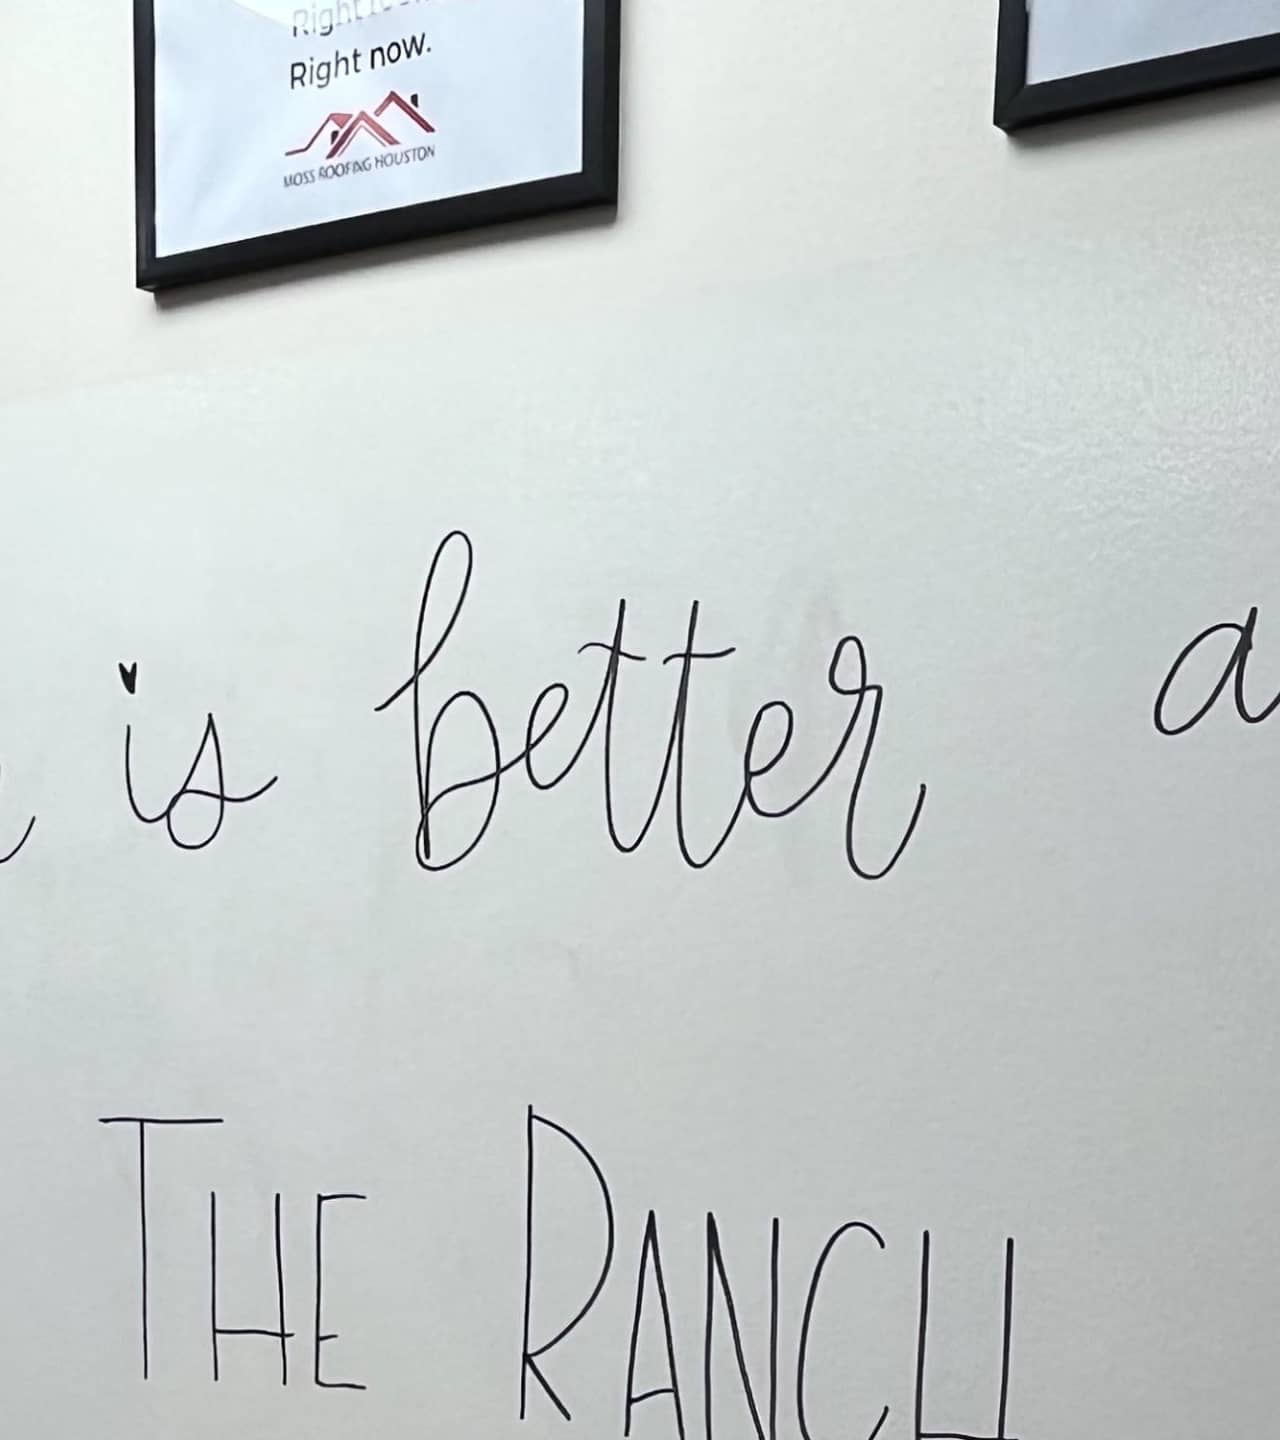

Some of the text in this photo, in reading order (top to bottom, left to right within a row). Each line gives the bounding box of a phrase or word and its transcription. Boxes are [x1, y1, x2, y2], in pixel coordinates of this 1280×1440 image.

[290, 32, 432, 89] Right now.
[283, 144, 435, 188] MOSS ROOFING HOUSTON
[118, 661, 278, 850] is
[376, 531, 926, 880] better
[98, 1116, 367, 1390] THE
